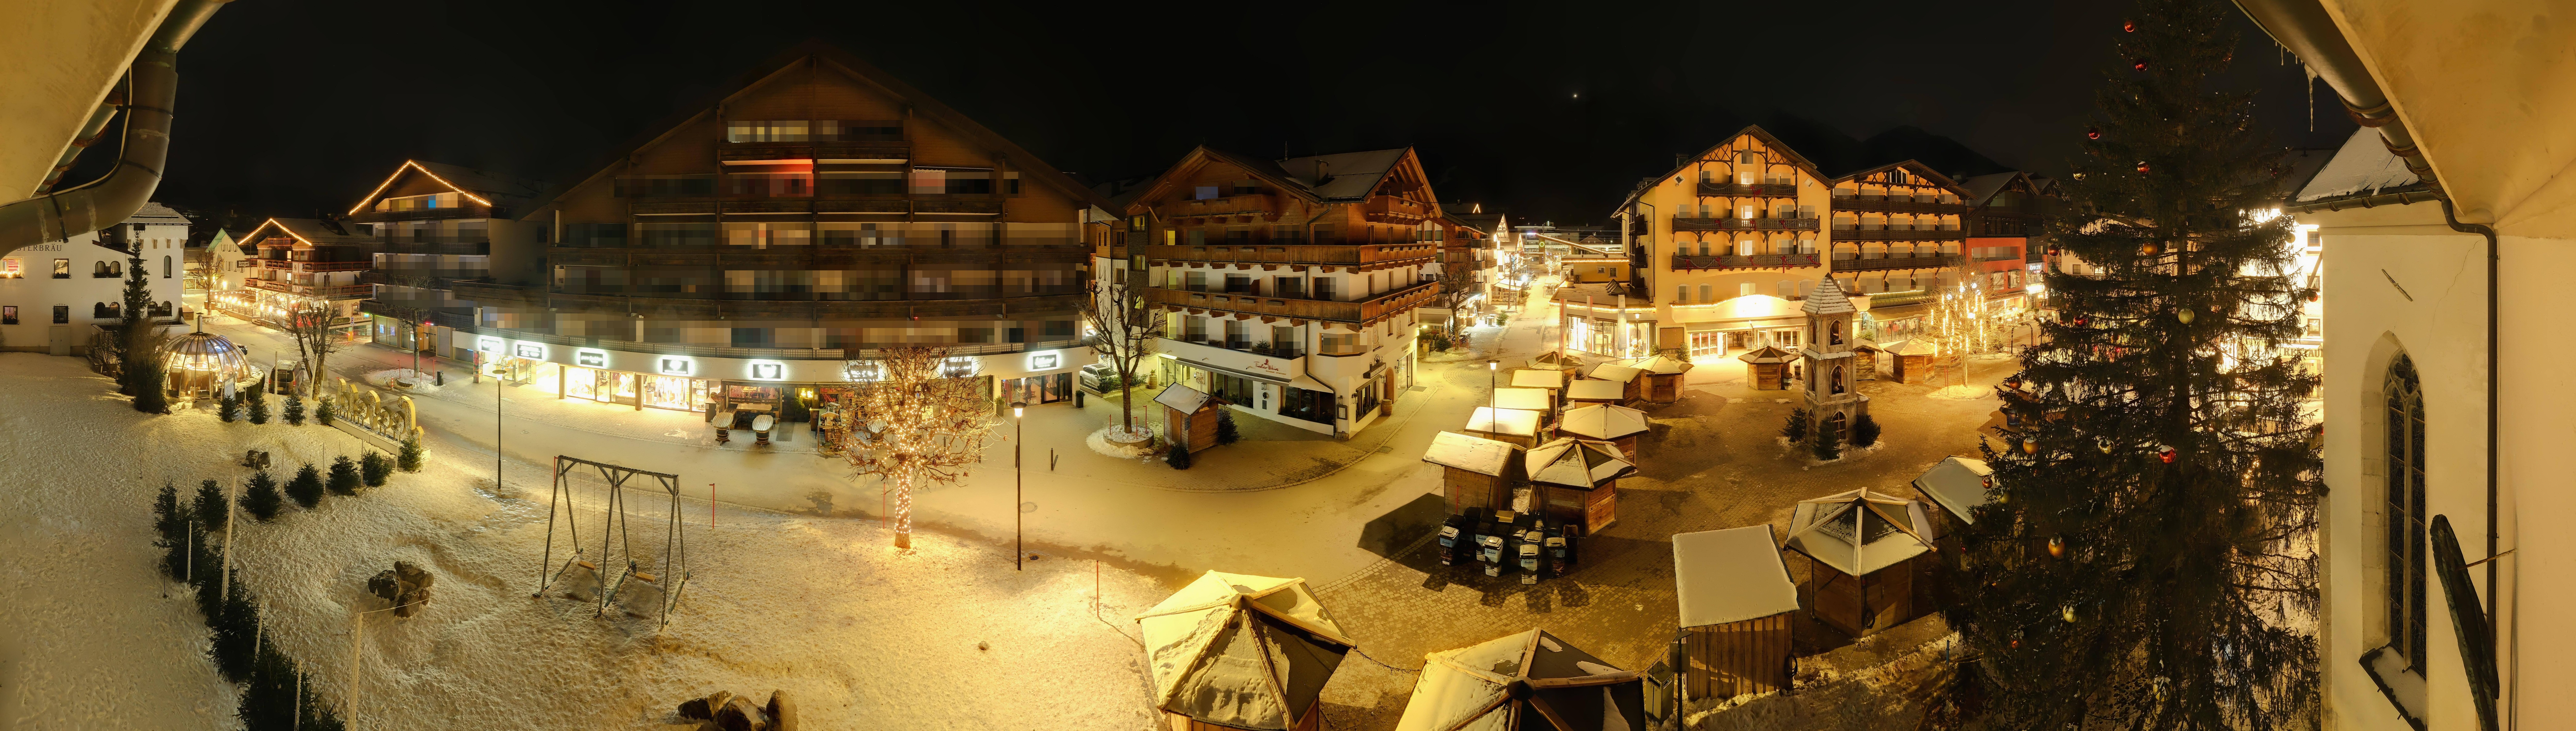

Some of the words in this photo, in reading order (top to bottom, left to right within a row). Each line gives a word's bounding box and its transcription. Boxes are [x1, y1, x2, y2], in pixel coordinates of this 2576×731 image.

[1401, 343, 1410, 351] SAILER
[2284, 348, 2323, 357] RETAU
[1371, 364, 1385, 377] RESTAURANT
